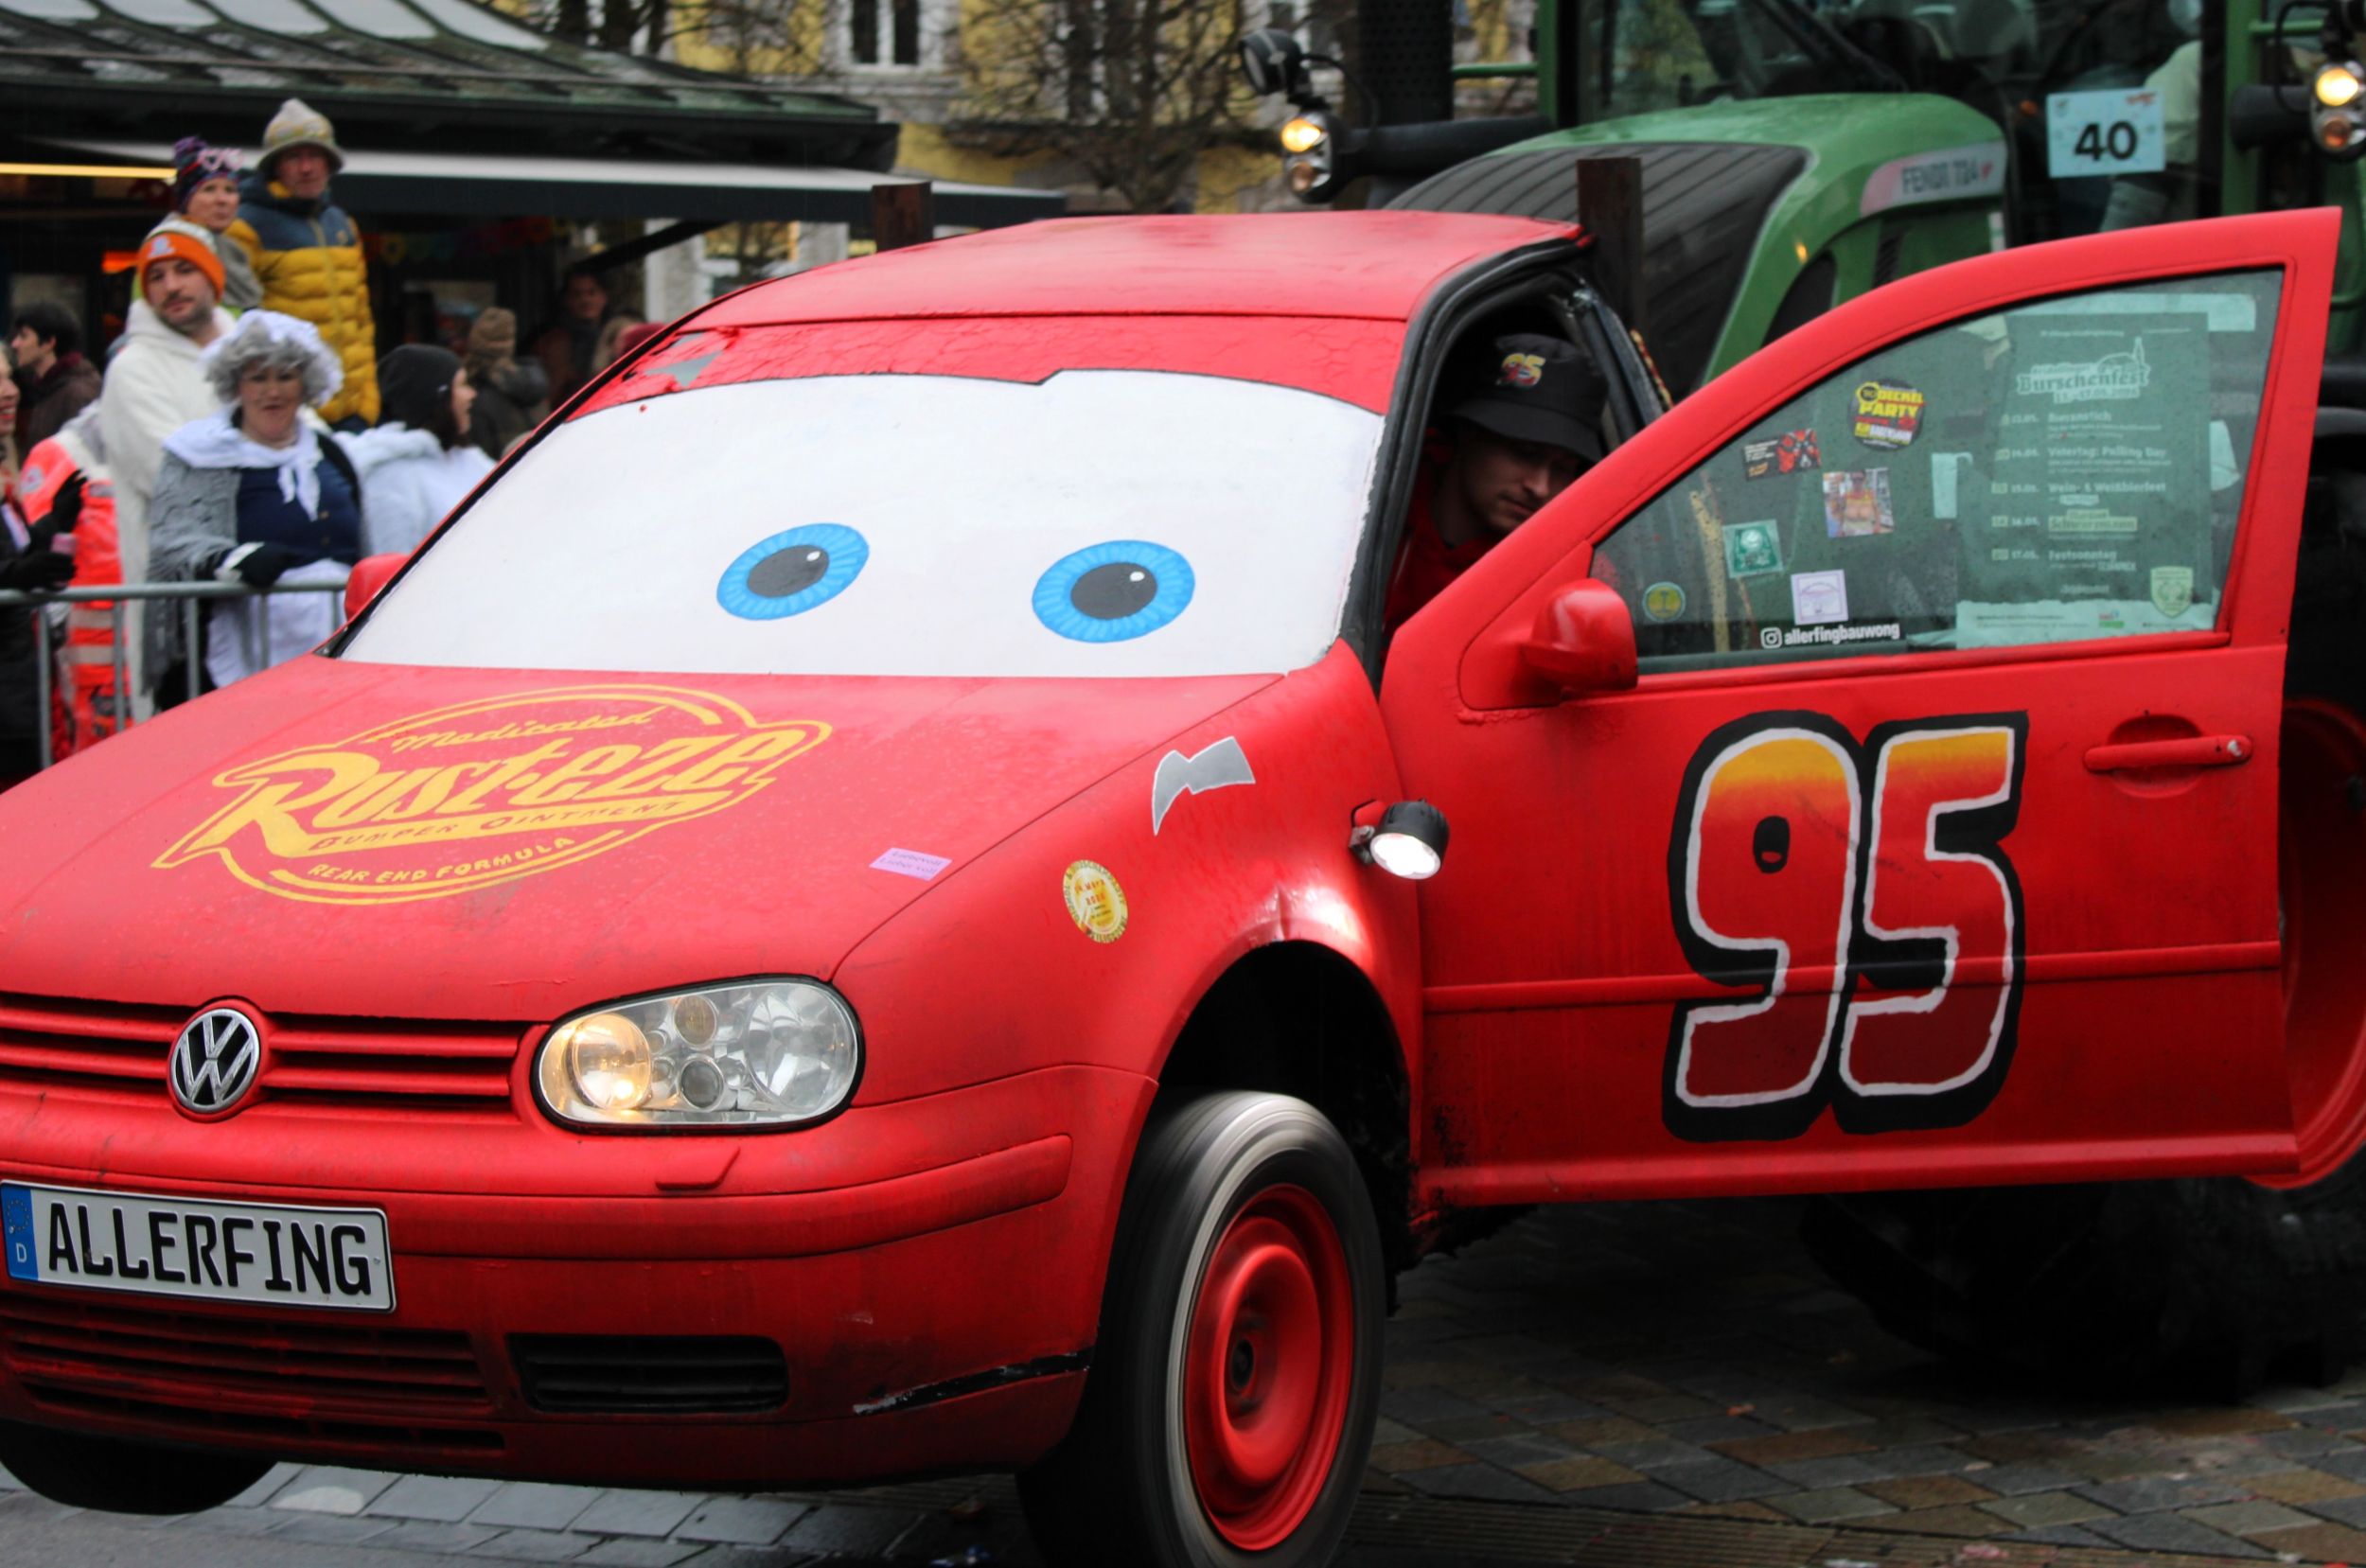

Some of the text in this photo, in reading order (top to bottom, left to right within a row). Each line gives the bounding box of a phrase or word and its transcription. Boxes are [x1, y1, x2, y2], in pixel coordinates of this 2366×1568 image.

[2074, 120, 2139, 161] 40
[1498, 352, 1546, 387] 95
[1859, 402, 1919, 418] PARTY
[1784, 622, 1899, 645] allerfingbauwong
[390, 705, 668, 754] Medicated
[309, 800, 689, 852] BUMPER OINTMENT
[309, 837, 575, 884] REAR END FORMULA
[1663, 711, 2028, 1141] 95
[170, 1009, 260, 1113] VW
[15, 1202, 372, 1295] D ALLERFING
